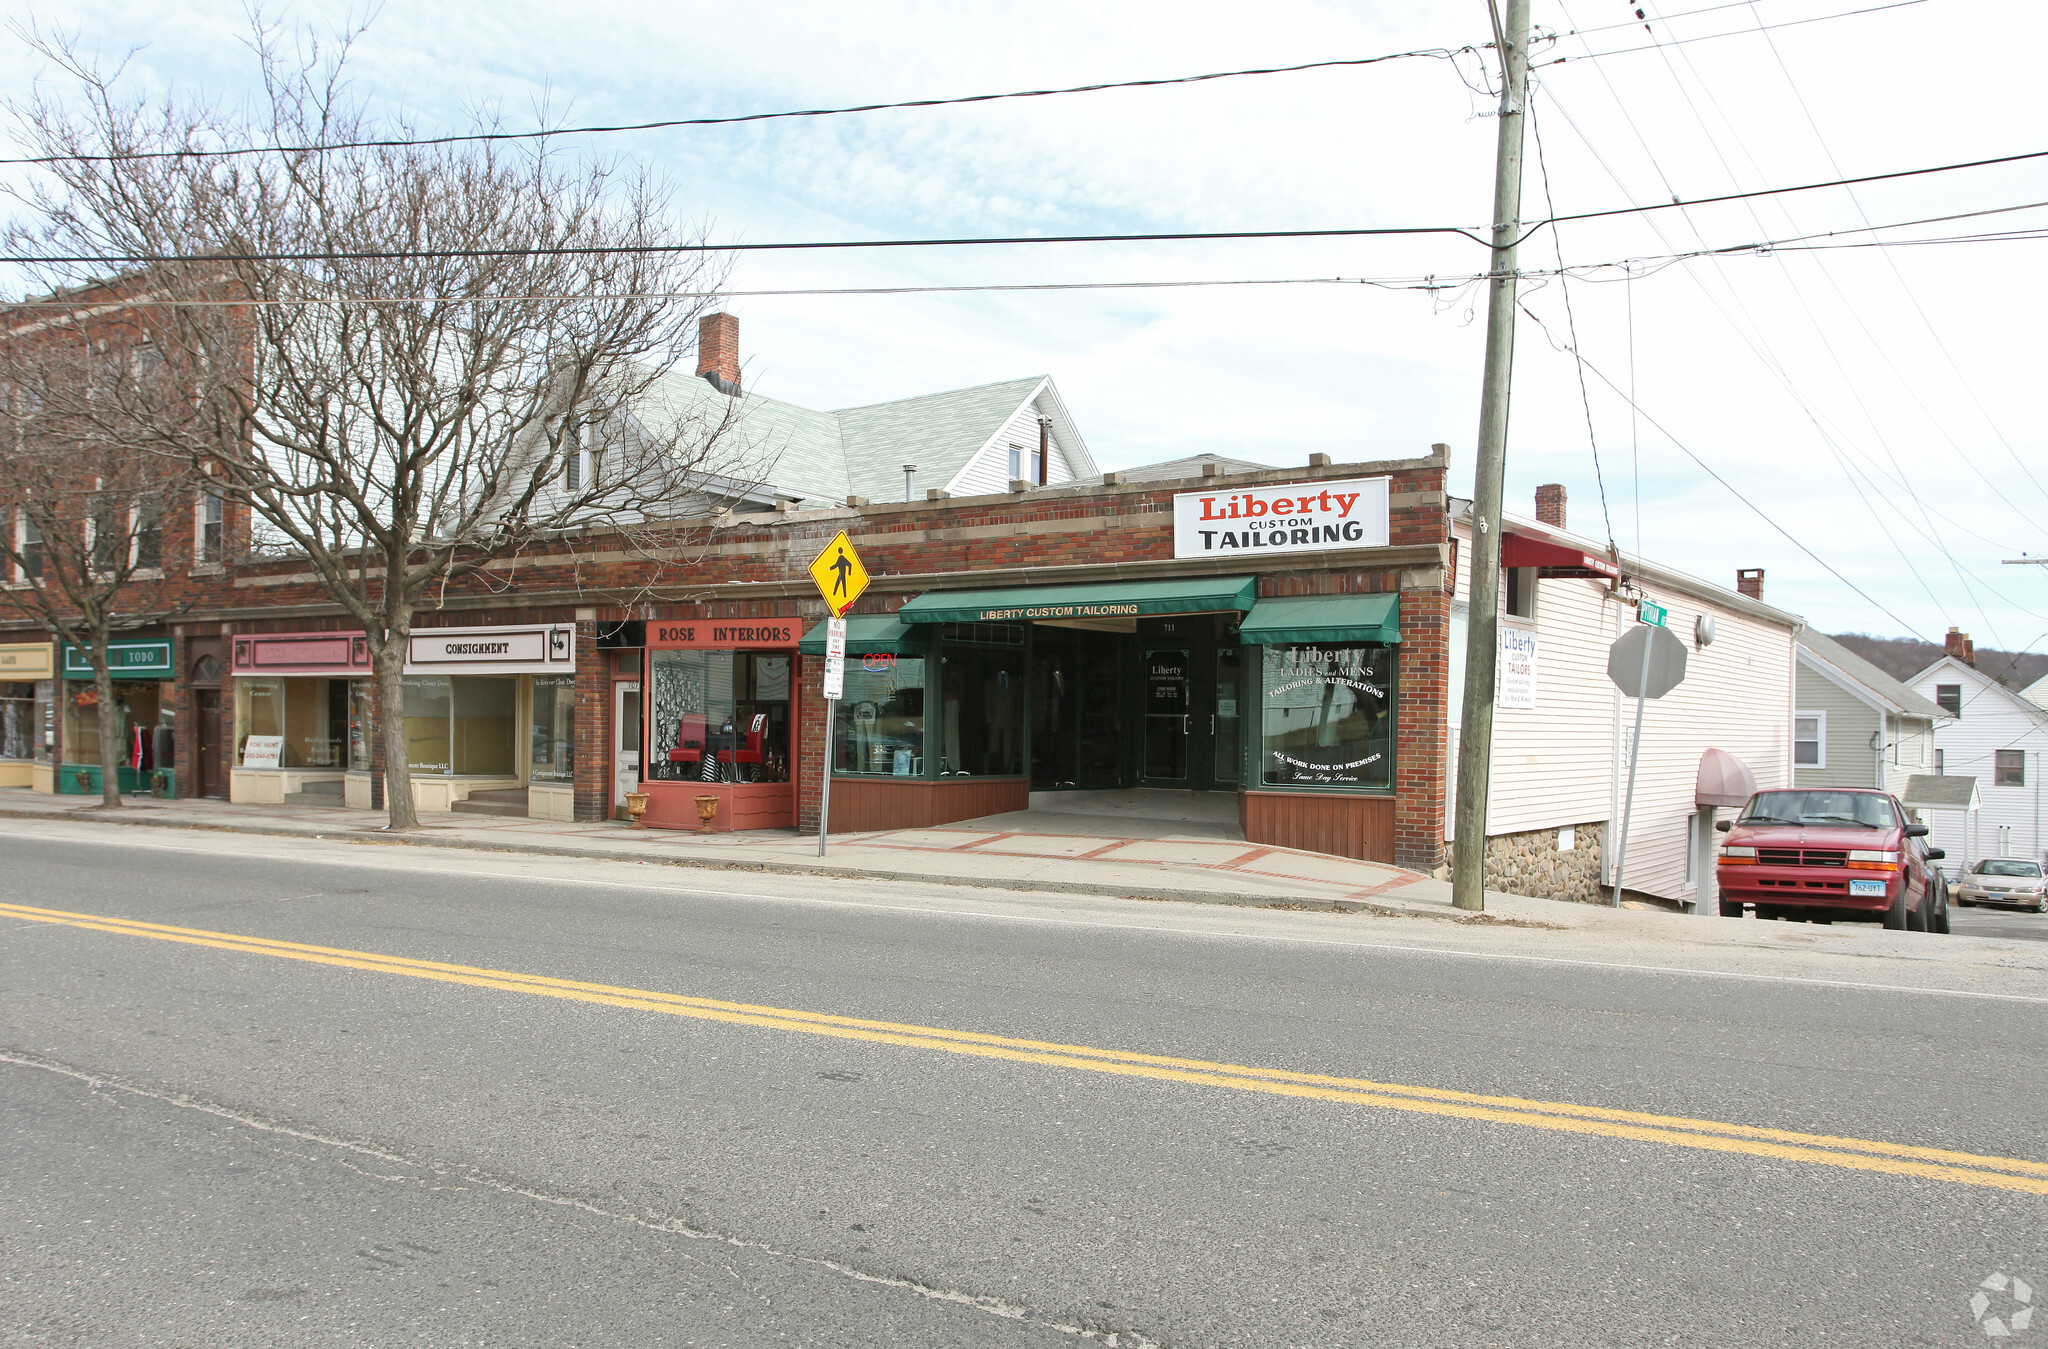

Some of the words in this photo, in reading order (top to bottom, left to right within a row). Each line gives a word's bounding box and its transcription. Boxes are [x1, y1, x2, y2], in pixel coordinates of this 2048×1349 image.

[1199, 489, 1361, 521] Liberty
[1249, 517, 1313, 530] CUSTOM
[1198, 520, 1363, 549] TAILORING
[980, 608, 1025, 620] LIBERTY
[1026, 606, 1073, 617] CUSTOM
[1076, 604, 1138, 615] TAILORING
[833, 621, 841, 630] NO
[659, 627, 695, 642] ROSE
[713, 627, 791, 642] INTERIORS
[828, 629, 845, 639] PARKING
[445, 642, 509, 655] CONSIGNMENT
[1504, 630, 1536, 658] Liberty
[129, 652, 154, 663] TODO
[863, 653, 896, 667] OPEN
[1291, 646, 1364, 667] Liberty
[1511, 652, 1529, 662] CUSTOM
[1152, 665, 1182, 676] Liberty
[1280, 667, 1323, 677] LADIES
[1338, 666, 1374, 677] MENS
[1508, 662, 1531, 676] TAILORS
[1267, 677, 1313, 699] TAILORING
[1315, 677, 1323, 685] &
[1325, 677, 1385, 699] ALTERATIONS
[419, 762, 438, 770] Boutique
[1272, 750, 1285, 760] ALL
[1286, 756, 1308, 769] WORK
[1309, 763, 1331, 771] DONE
[1345, 752, 1382, 770] PREMISES
[1292, 771, 1313, 780] Same
[1315, 772, 1332, 783] Day
[1332, 772, 1358, 782] Service
